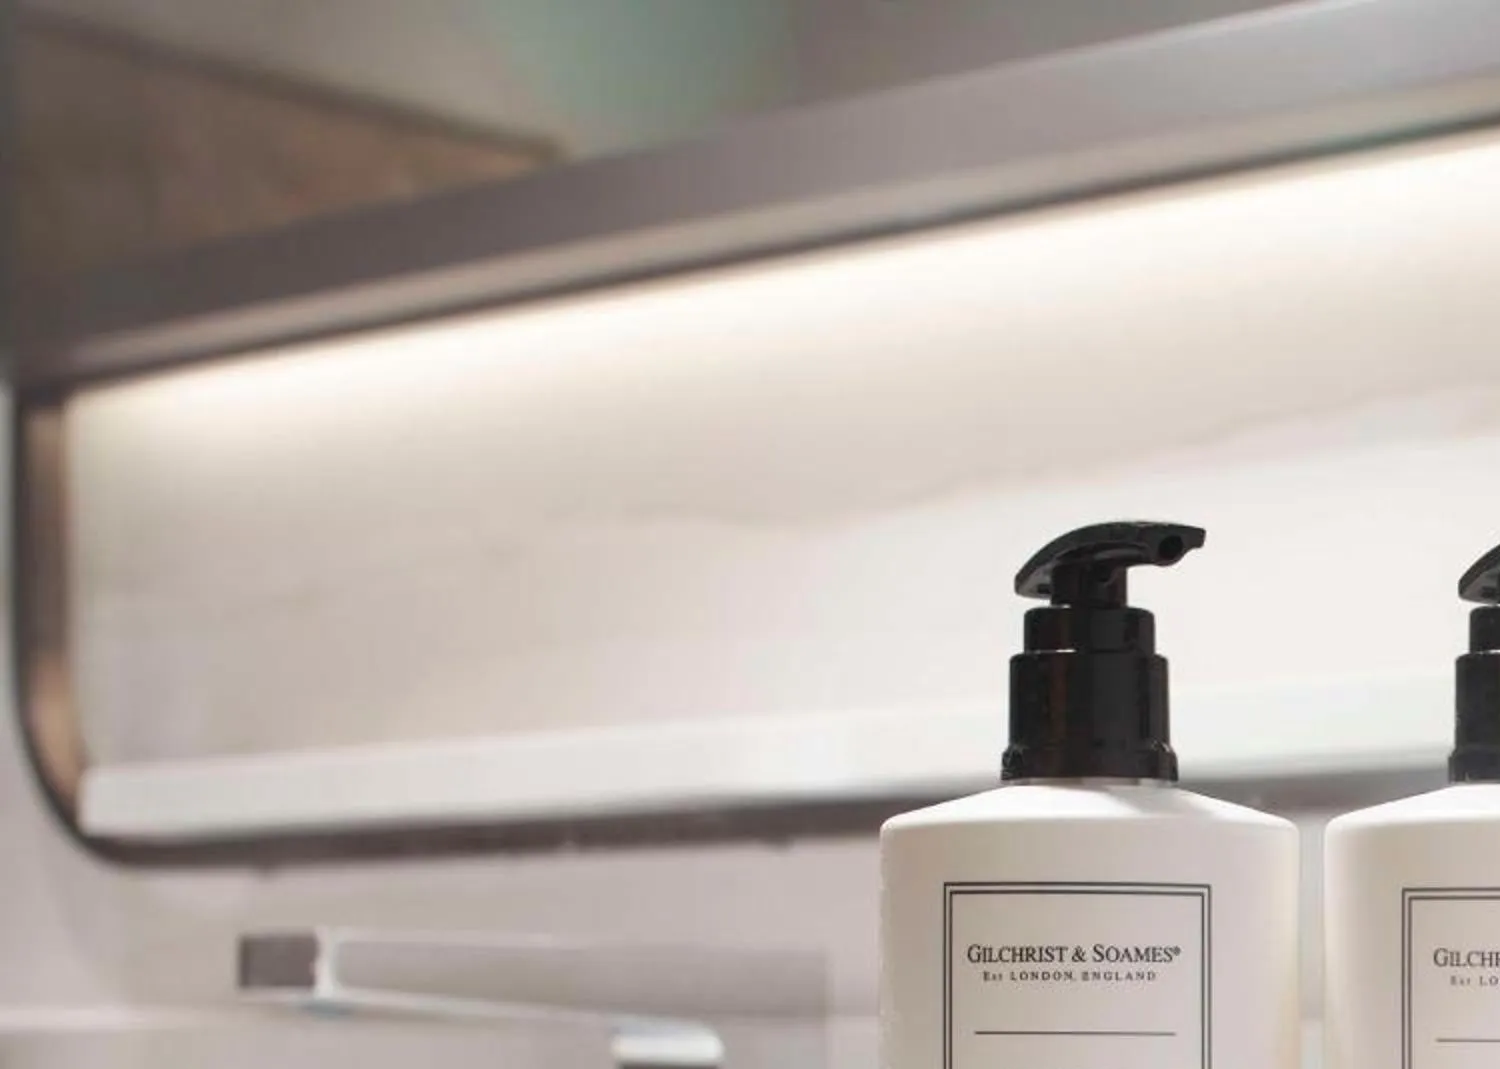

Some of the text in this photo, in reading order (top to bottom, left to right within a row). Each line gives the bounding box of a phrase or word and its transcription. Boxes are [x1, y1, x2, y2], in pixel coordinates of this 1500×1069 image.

[967, 944, 1069, 964] GILCHRIST
[1071, 946, 1087, 962] &
[1081, 968, 1156, 984] ENGLAND
